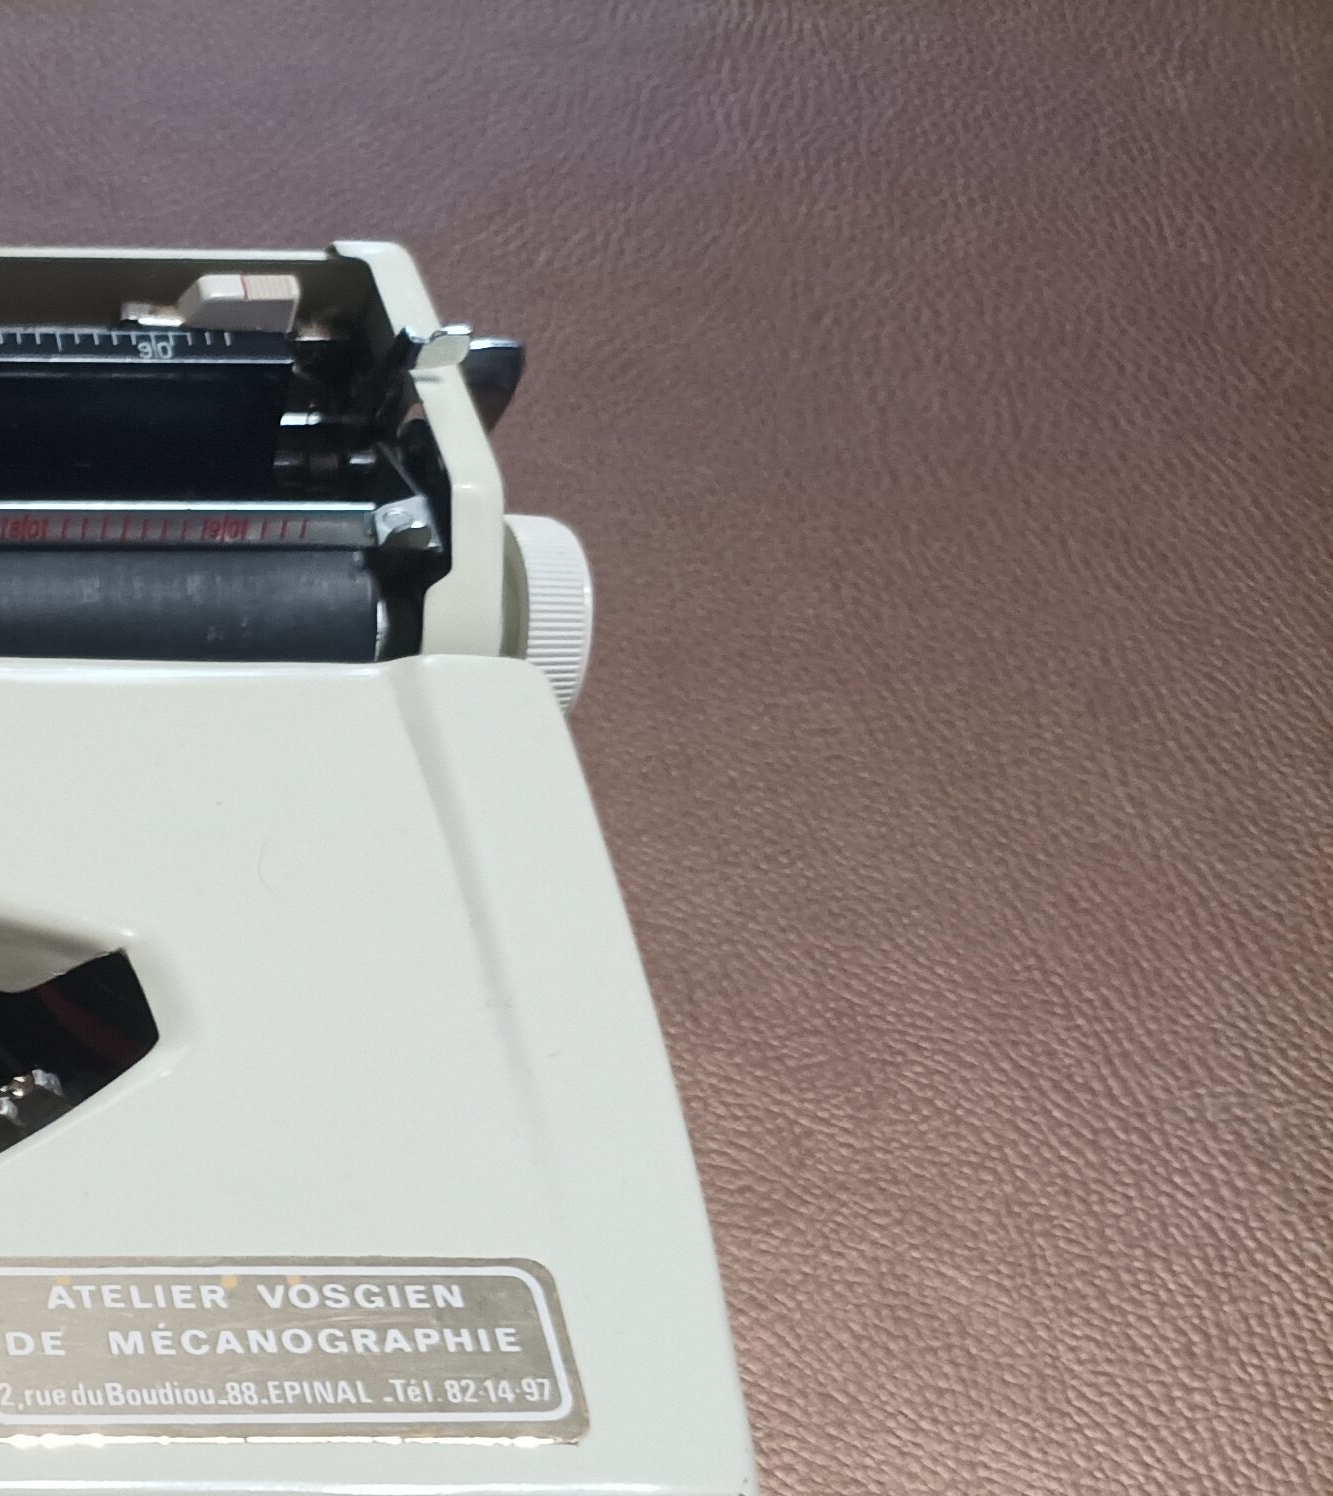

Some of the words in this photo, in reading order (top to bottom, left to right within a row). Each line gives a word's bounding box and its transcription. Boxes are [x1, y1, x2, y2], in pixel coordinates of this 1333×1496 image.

[46, 1284, 229, 1309] ATELIER
[257, 1283, 465, 1309] VOSGIEN
[5, 1330, 66, 1356] DE
[107, 1322, 523, 1355] MÉCANOGRAPHIE
